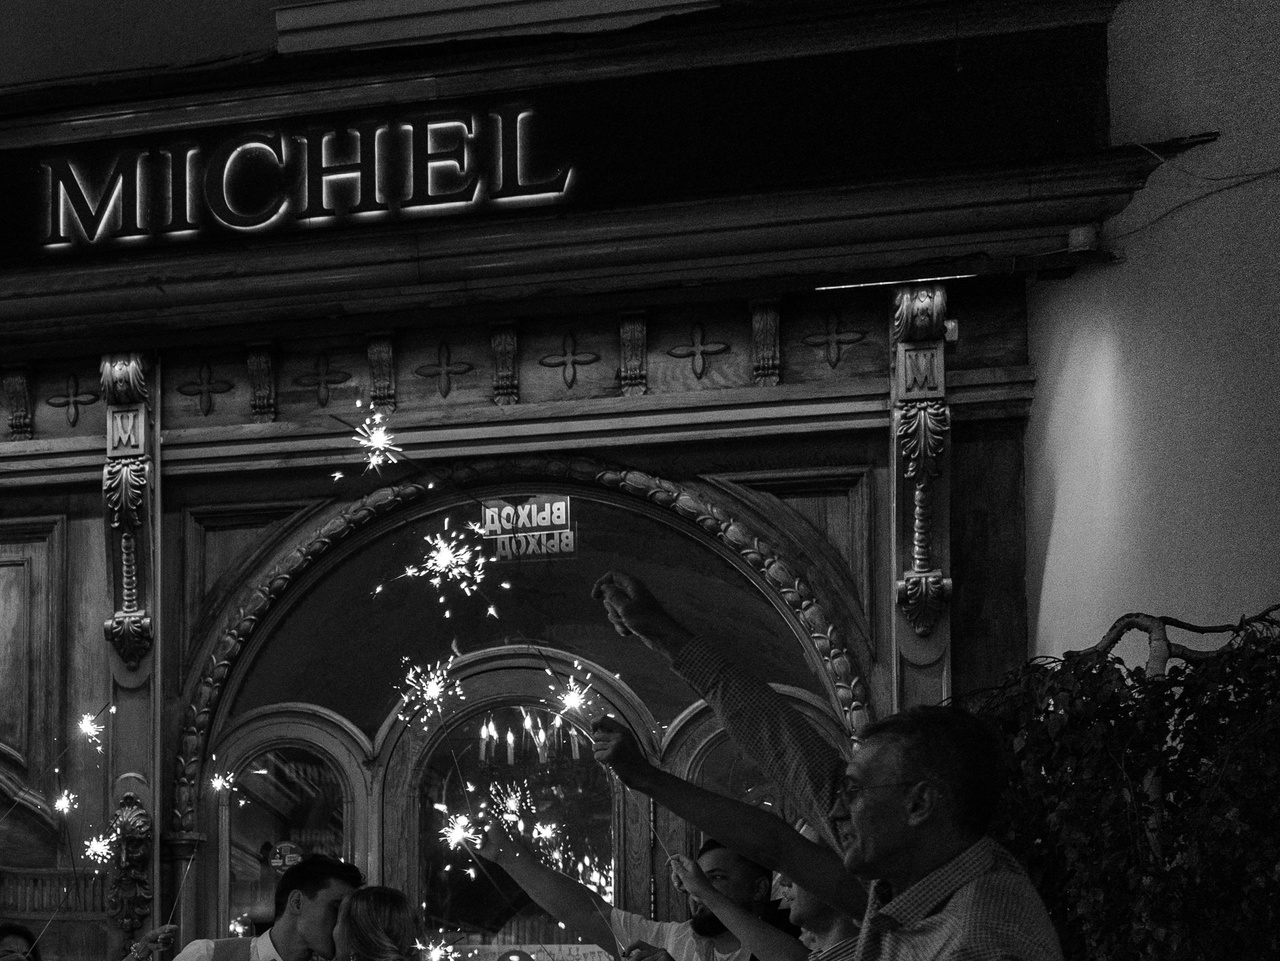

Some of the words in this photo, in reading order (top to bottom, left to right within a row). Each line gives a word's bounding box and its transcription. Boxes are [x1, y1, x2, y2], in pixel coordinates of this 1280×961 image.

[40, 110, 574, 247] MICHEL
[905, 352, 939, 392] M
[113, 412, 139, 449] M
